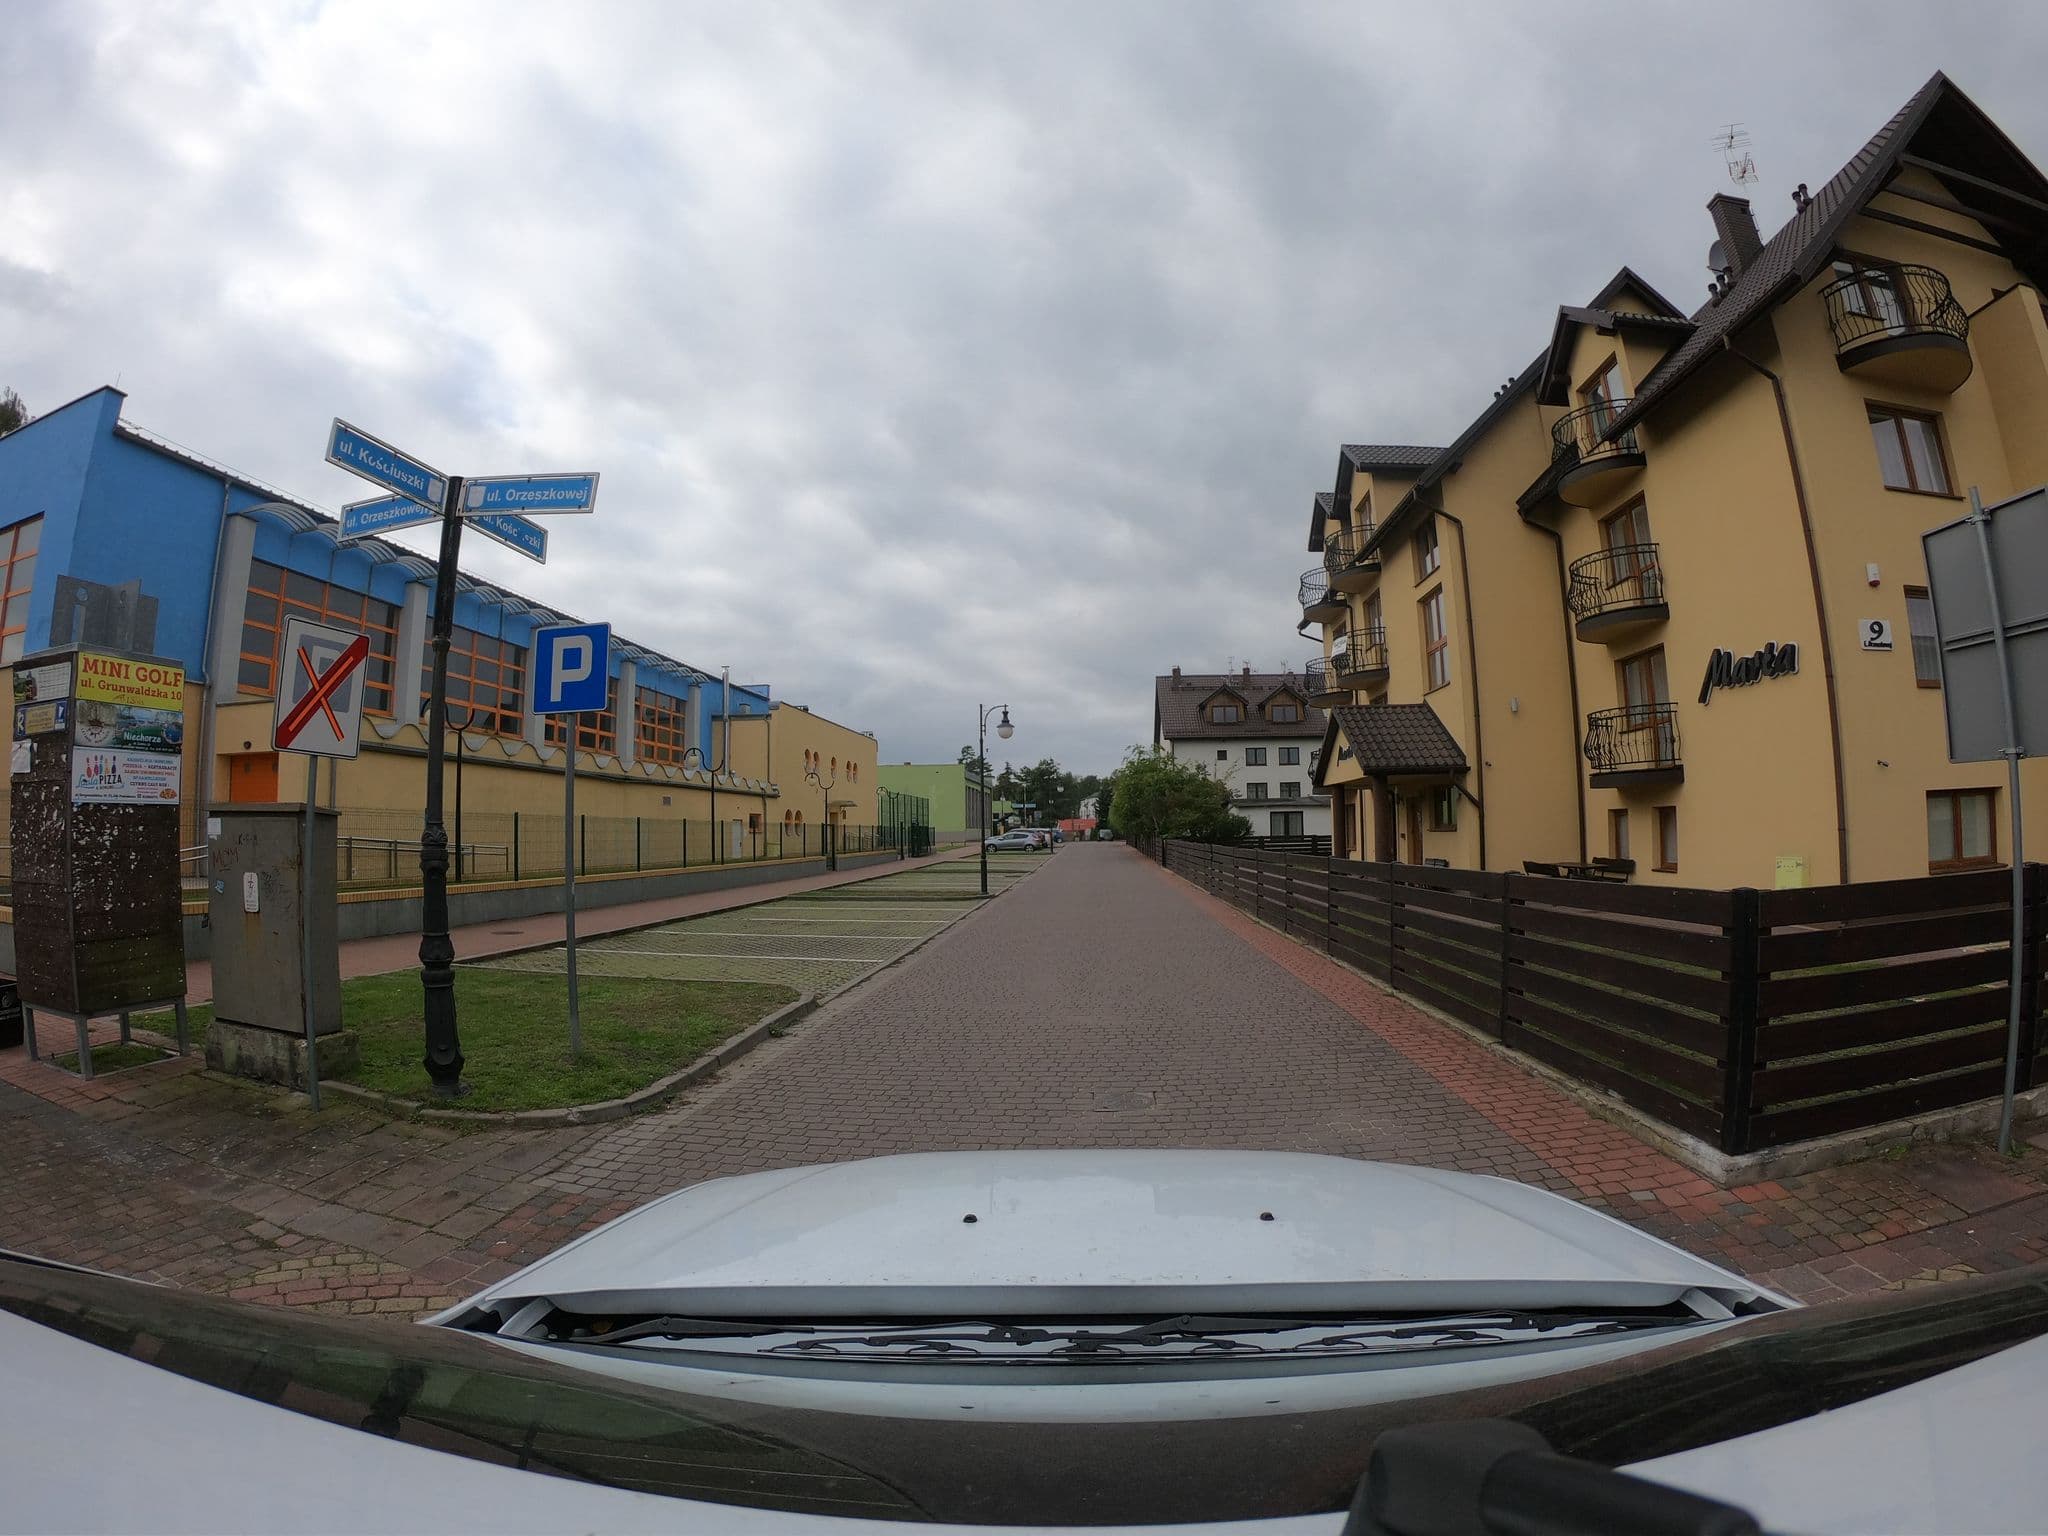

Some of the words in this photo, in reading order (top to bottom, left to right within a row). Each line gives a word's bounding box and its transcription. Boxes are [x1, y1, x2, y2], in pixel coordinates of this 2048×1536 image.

[339, 440, 355, 457] ul.
[358, 447, 425, 491] Kościuszki
[486, 489, 502, 502] ul.
[505, 487, 589, 502] Orzeszkowej
[346, 515, 358, 528] ul.
[1869, 620, 1884, 641] 9
[82, 656, 131, 680] MINI
[135, 666, 183, 688] GOLF
[550, 635, 593, 703] P
[1698, 641, 1798, 705] Marta
[80, 677, 95, 689] ul.
[98, 679, 169, 699] Grunwaldzka
[170, 690, 183, 701] 10
[99, 774, 123, 785] PIZZA
